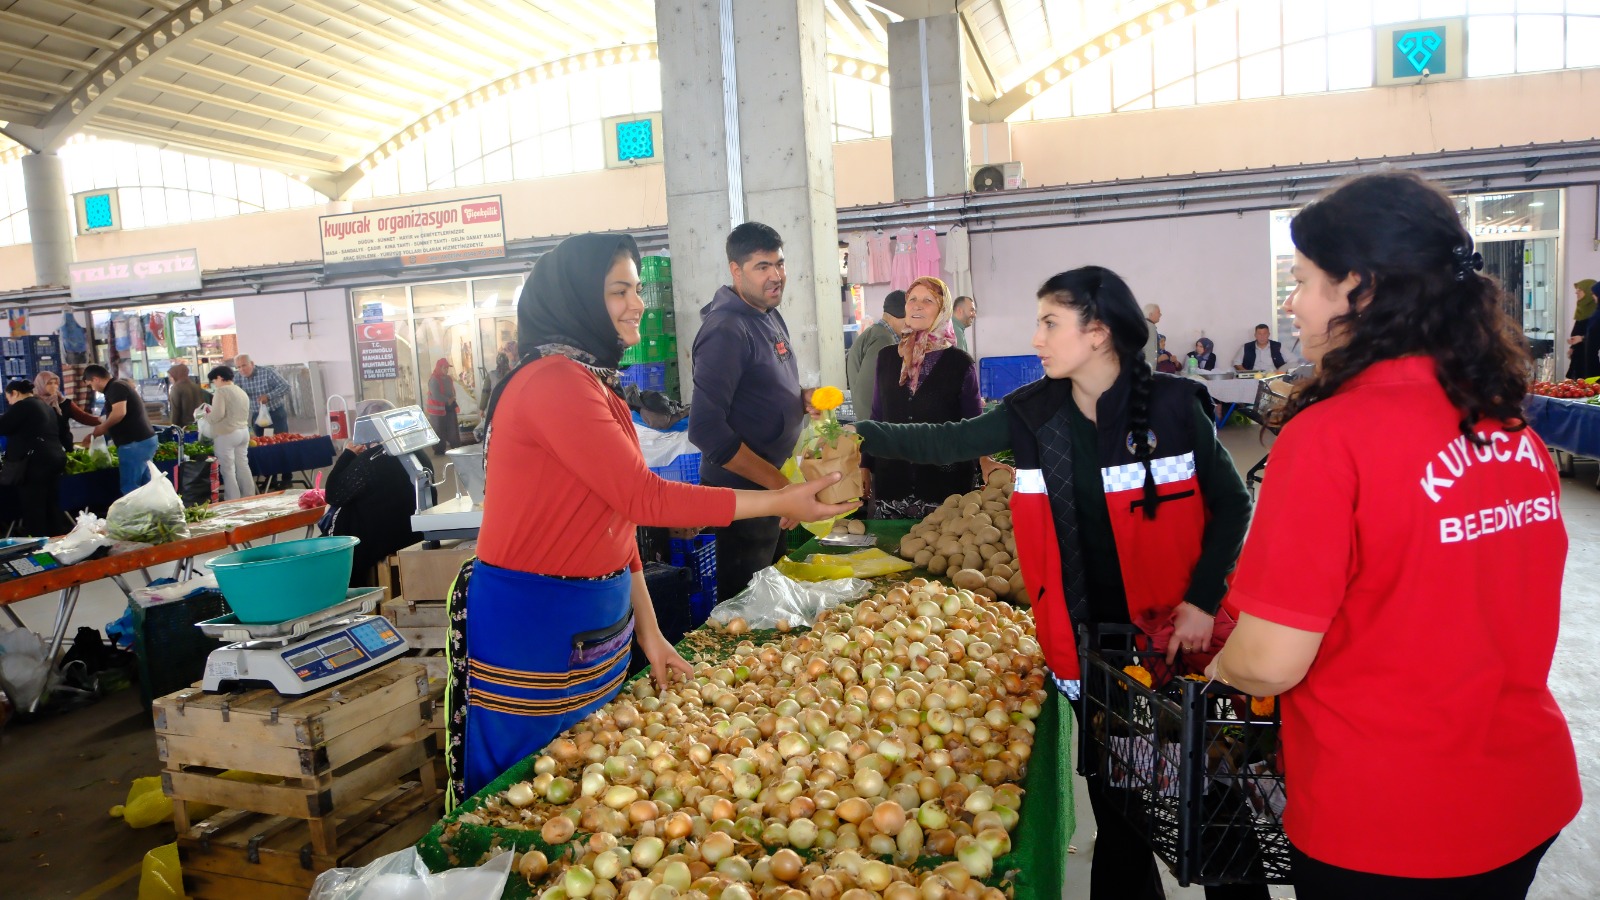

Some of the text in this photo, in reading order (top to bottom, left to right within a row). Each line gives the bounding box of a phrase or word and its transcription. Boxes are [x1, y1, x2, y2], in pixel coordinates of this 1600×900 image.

[324, 209, 458, 240] kuyucak organizasyon
[71, 255, 195, 282] YELİZ ÇEYİZ
[362, 347, 393, 355] AYDINOĞLU
[362, 353, 394, 361] MAHALLESİ
[362, 360, 395, 368] MUHTARLIĞI
[1420, 431, 1545, 503] KUYUCA
[1440, 491, 1557, 543] BEEDİYESİ
